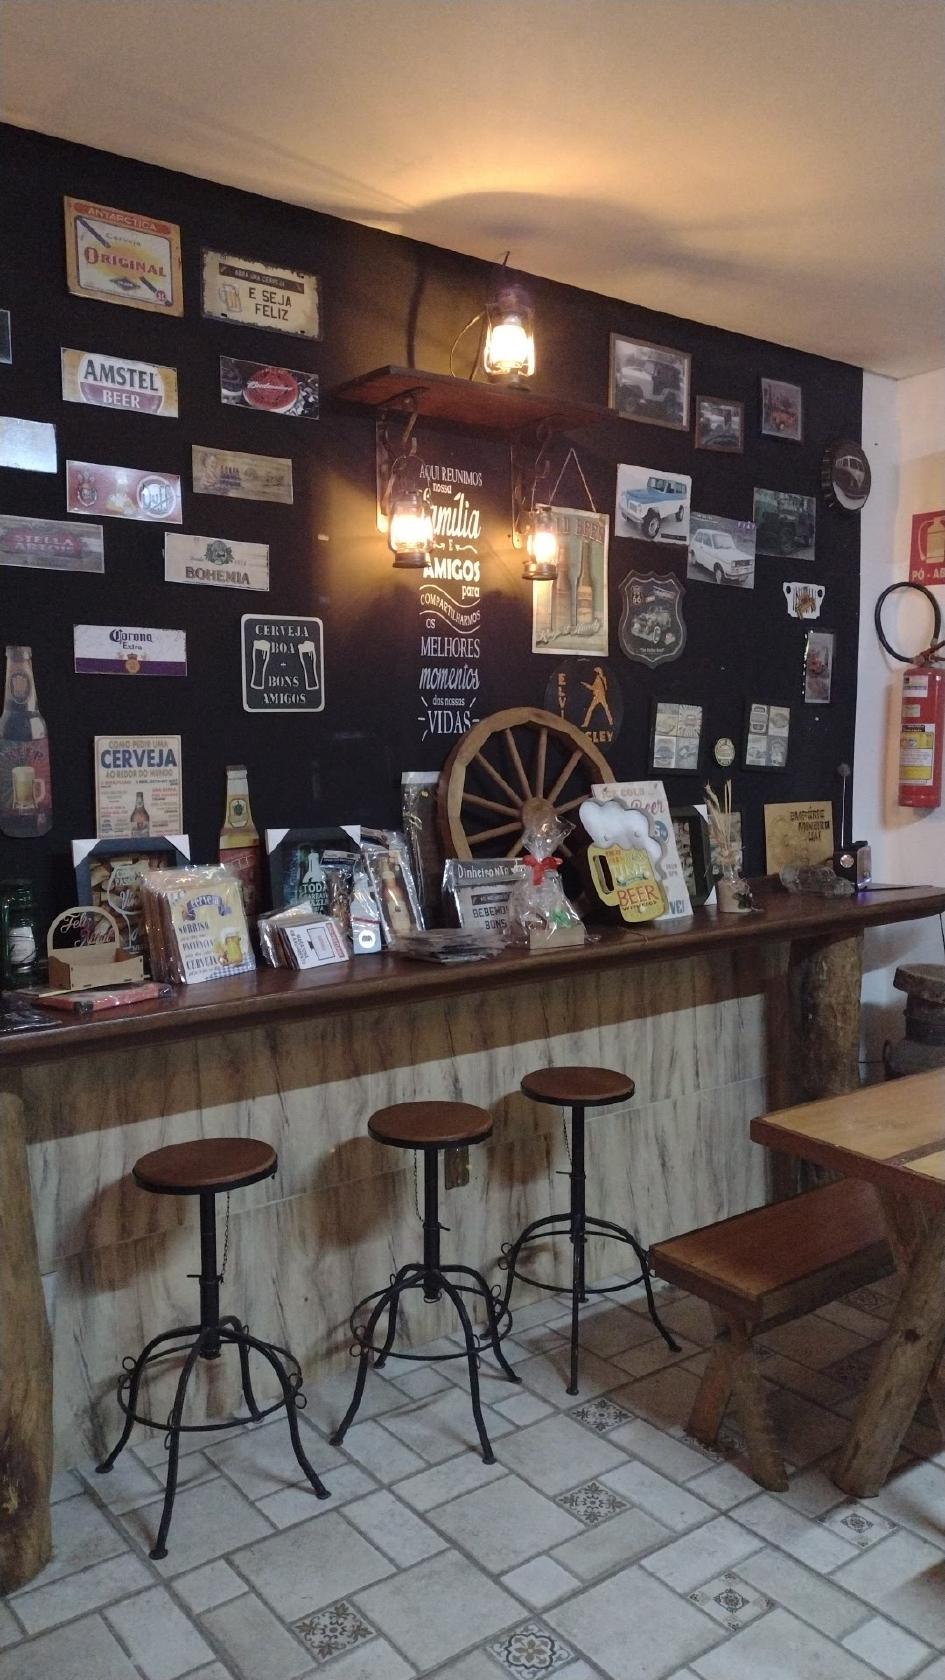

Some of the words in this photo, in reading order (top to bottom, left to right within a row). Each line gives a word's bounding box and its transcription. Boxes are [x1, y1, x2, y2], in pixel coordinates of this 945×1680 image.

[87, 208, 157, 231] ANTARCTICA
[84, 246, 167, 278] ORIGINAL
[248, 286, 257, 300] E
[262, 289, 292, 308] SEJA
[255, 303, 289, 321] FELIZ
[83, 359, 159, 392] AMSTEL
[102, 389, 141, 408] BEER
[419, 463, 439, 481] AQUI
[441, 466, 482, 487] REUNIMOS
[432, 482, 452, 494] nossa
[185, 566, 250, 585] BOHEMIA
[423, 553, 480, 582] AMIGOS
[911, 567, 925, 581] PÓ
[461, 585, 480, 599] para
[109, 628, 153, 645] Corona
[255, 624, 309, 637] CERVEJA
[122, 642, 143, 650] Extra
[271, 641, 296, 654] BOA
[420, 636, 480, 658] MELHORES
[268, 675, 300, 688] BONS
[419, 663, 480, 690] momentos
[263, 693, 306, 705] AMIGOS
[445, 696, 465, 706] nossas
[427, 710, 471, 734] VIDAS
[101, 748, 178, 769] CERVEJA
[457, 864, 493, 879] Dinheiro
[617, 885, 659, 907] BEER
[484, 918, 508, 930] BONS
